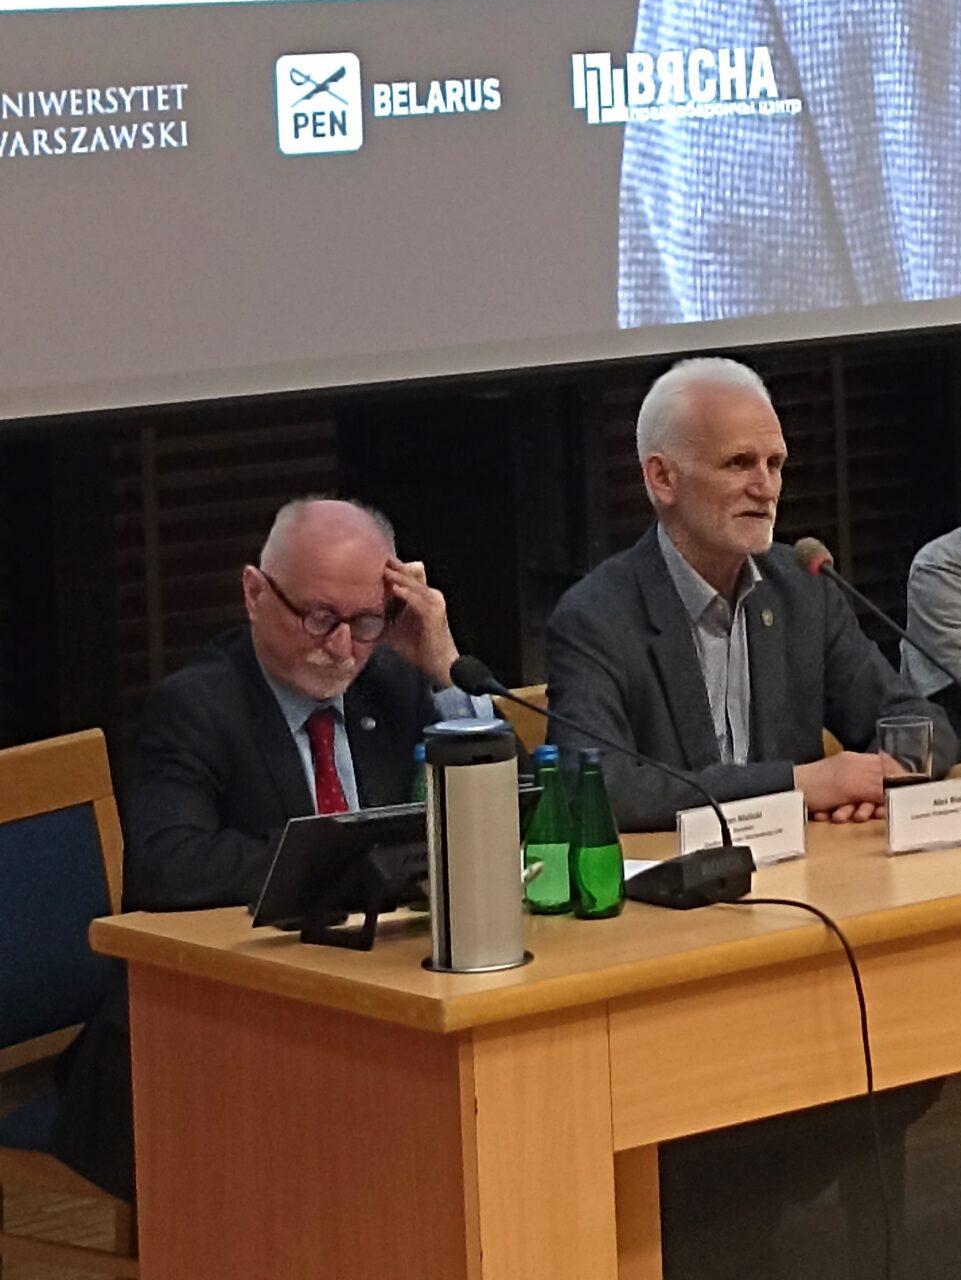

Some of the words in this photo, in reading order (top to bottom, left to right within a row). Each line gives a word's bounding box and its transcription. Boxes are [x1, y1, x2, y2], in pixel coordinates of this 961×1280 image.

[625, 46, 779, 106] ВЯСНА
[1, 83, 189, 119] NIWERSYTET
[373, 77, 501, 117] BELARUS
[292, 110, 348, 140] PEN
